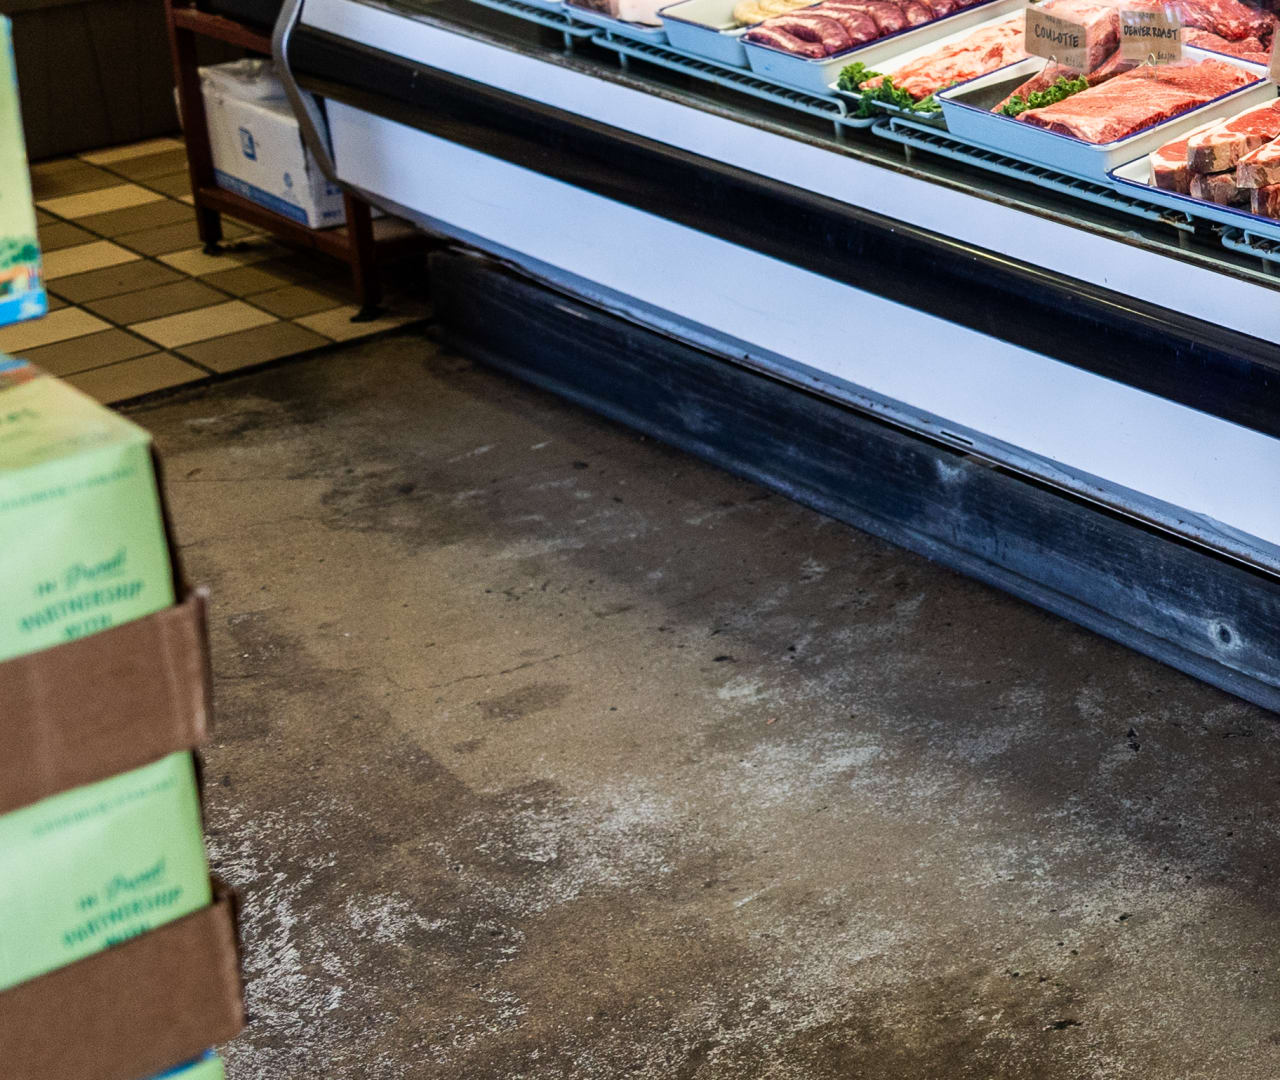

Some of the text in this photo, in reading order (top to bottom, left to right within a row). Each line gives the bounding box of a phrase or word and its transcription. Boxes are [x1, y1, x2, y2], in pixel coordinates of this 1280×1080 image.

[1034, 25, 1079, 48] COULOTTE
[1123, 25, 1178, 40] DENVER ROAST
